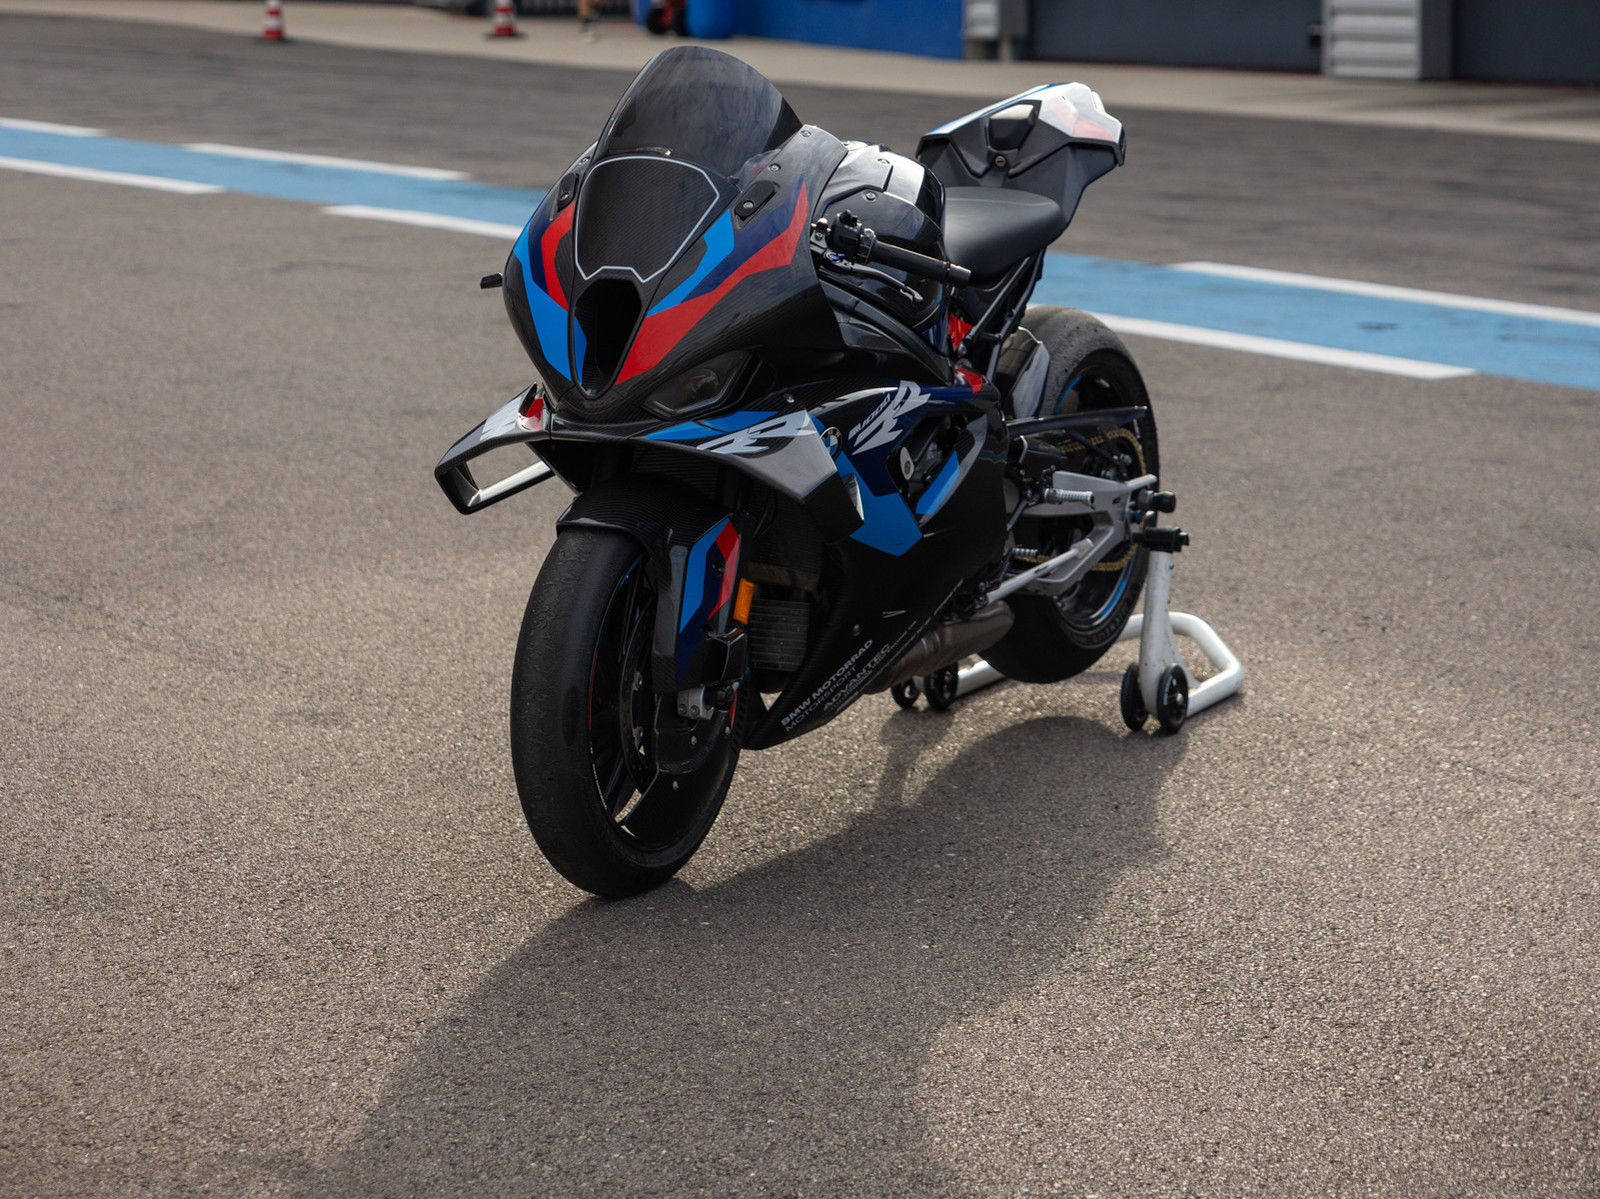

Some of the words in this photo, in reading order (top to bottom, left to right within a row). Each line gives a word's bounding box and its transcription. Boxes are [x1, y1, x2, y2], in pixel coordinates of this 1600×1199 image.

[780, 699, 812, 727] BMW
[811, 639, 873, 698] MOTORRAD
[785, 665, 857, 732] MOTORSPORT
[823, 643, 891, 712] ADVANTEC
